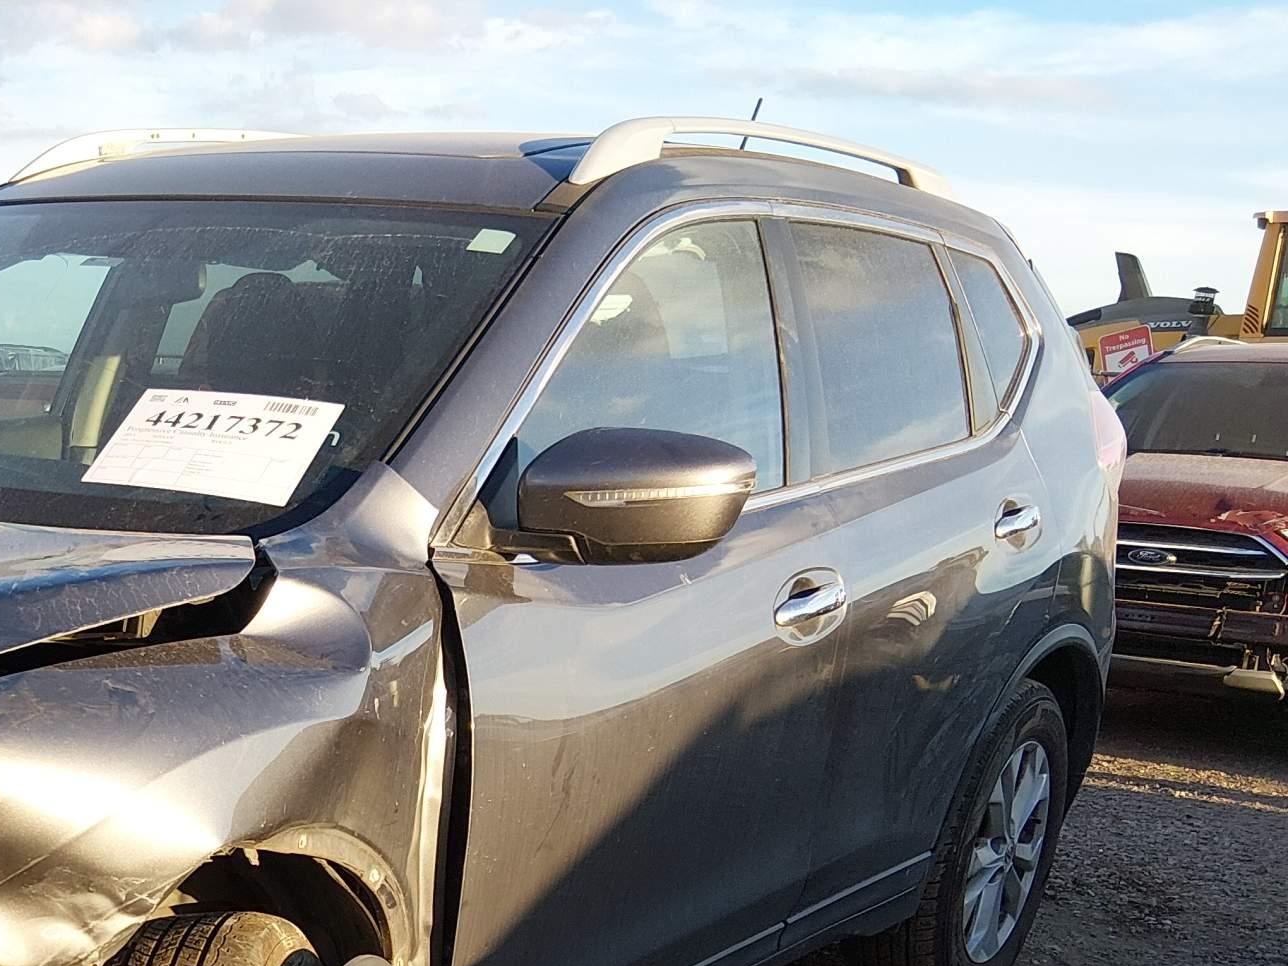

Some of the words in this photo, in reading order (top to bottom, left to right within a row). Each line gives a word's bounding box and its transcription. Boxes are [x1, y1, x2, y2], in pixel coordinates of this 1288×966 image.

[1149, 320, 1192, 328] VOLV
[1105, 338, 1146, 352] Trespassing
[145, 409, 303, 441] 44217372
